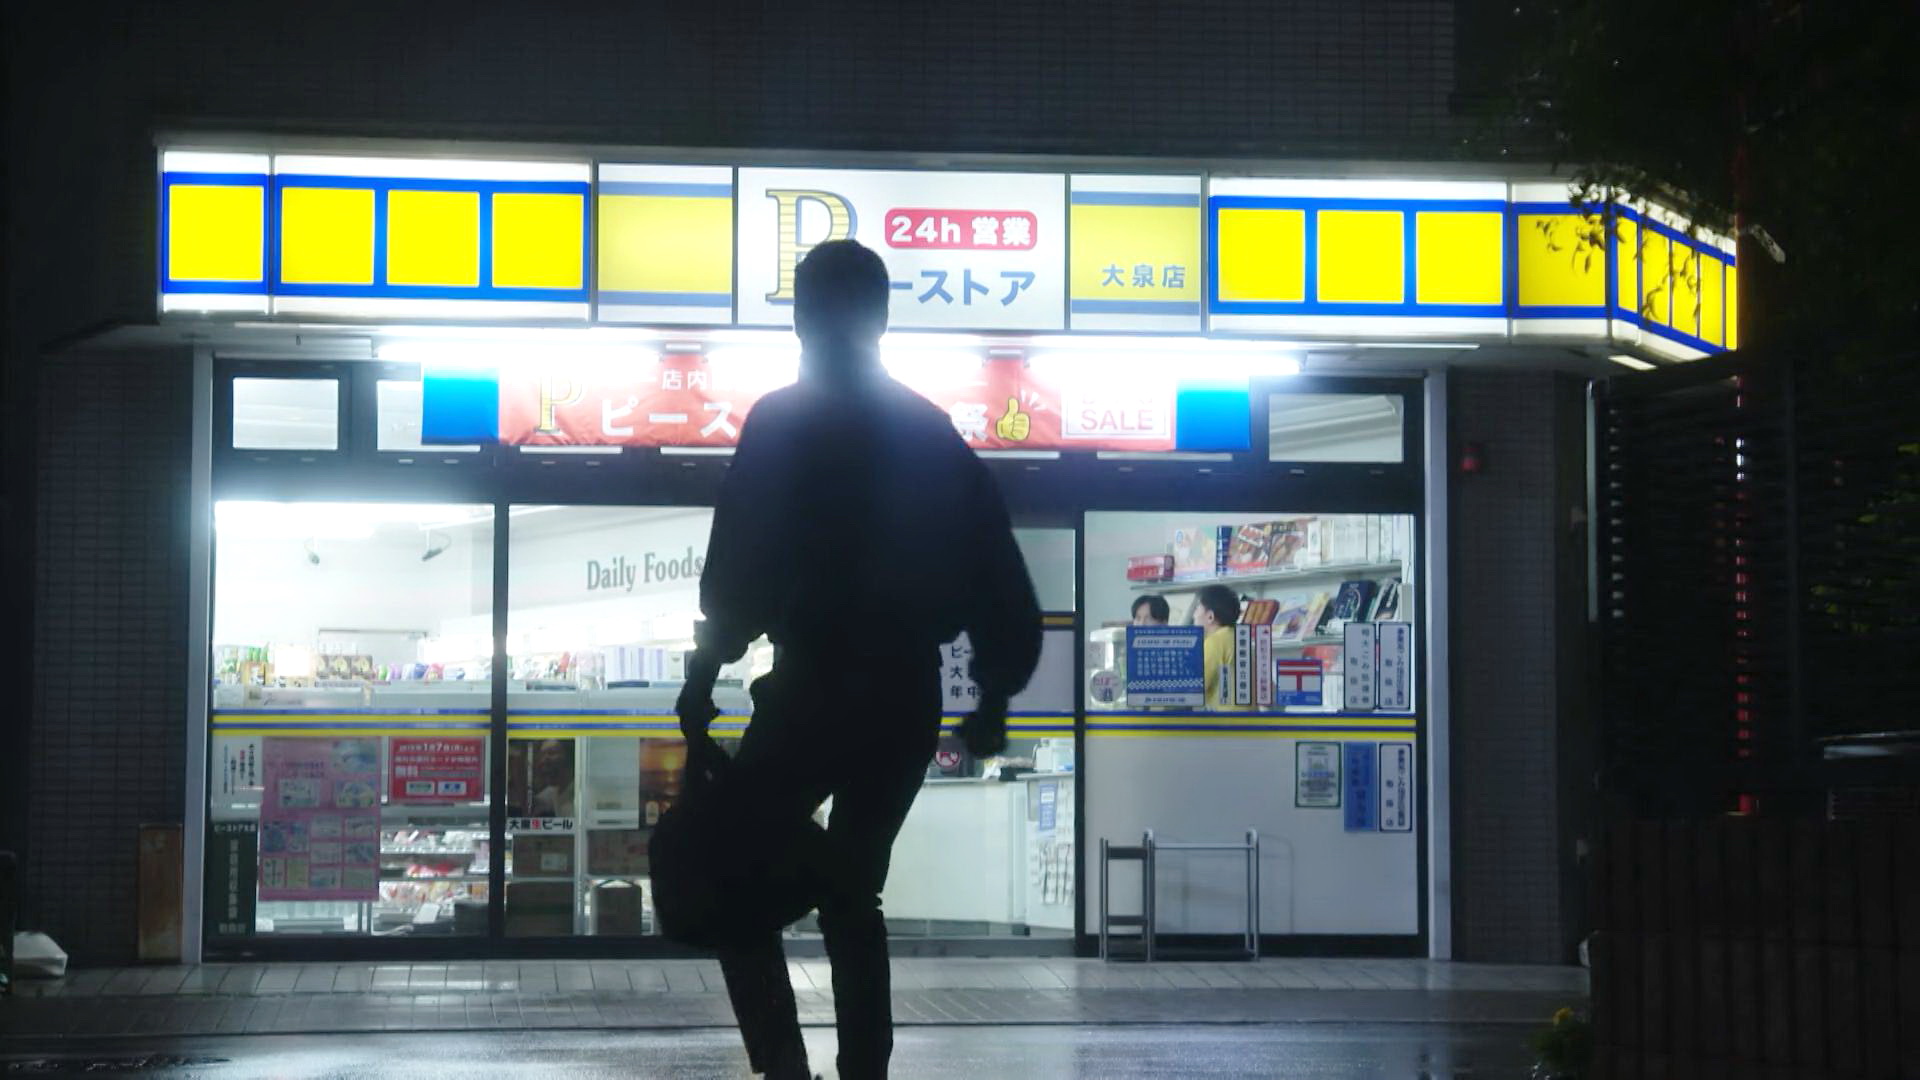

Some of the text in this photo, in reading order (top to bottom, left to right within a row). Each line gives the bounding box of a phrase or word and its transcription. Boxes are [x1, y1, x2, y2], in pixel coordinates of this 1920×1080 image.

[765, 188, 857, 304] P
[891, 215, 1032, 246] 24h 営業
[889, 268, 1036, 306] ーストア
[1101, 264, 1186, 289] 大泉店
[1080, 409, 1154, 432] SALE
[586, 545, 706, 592] Daily Foods
